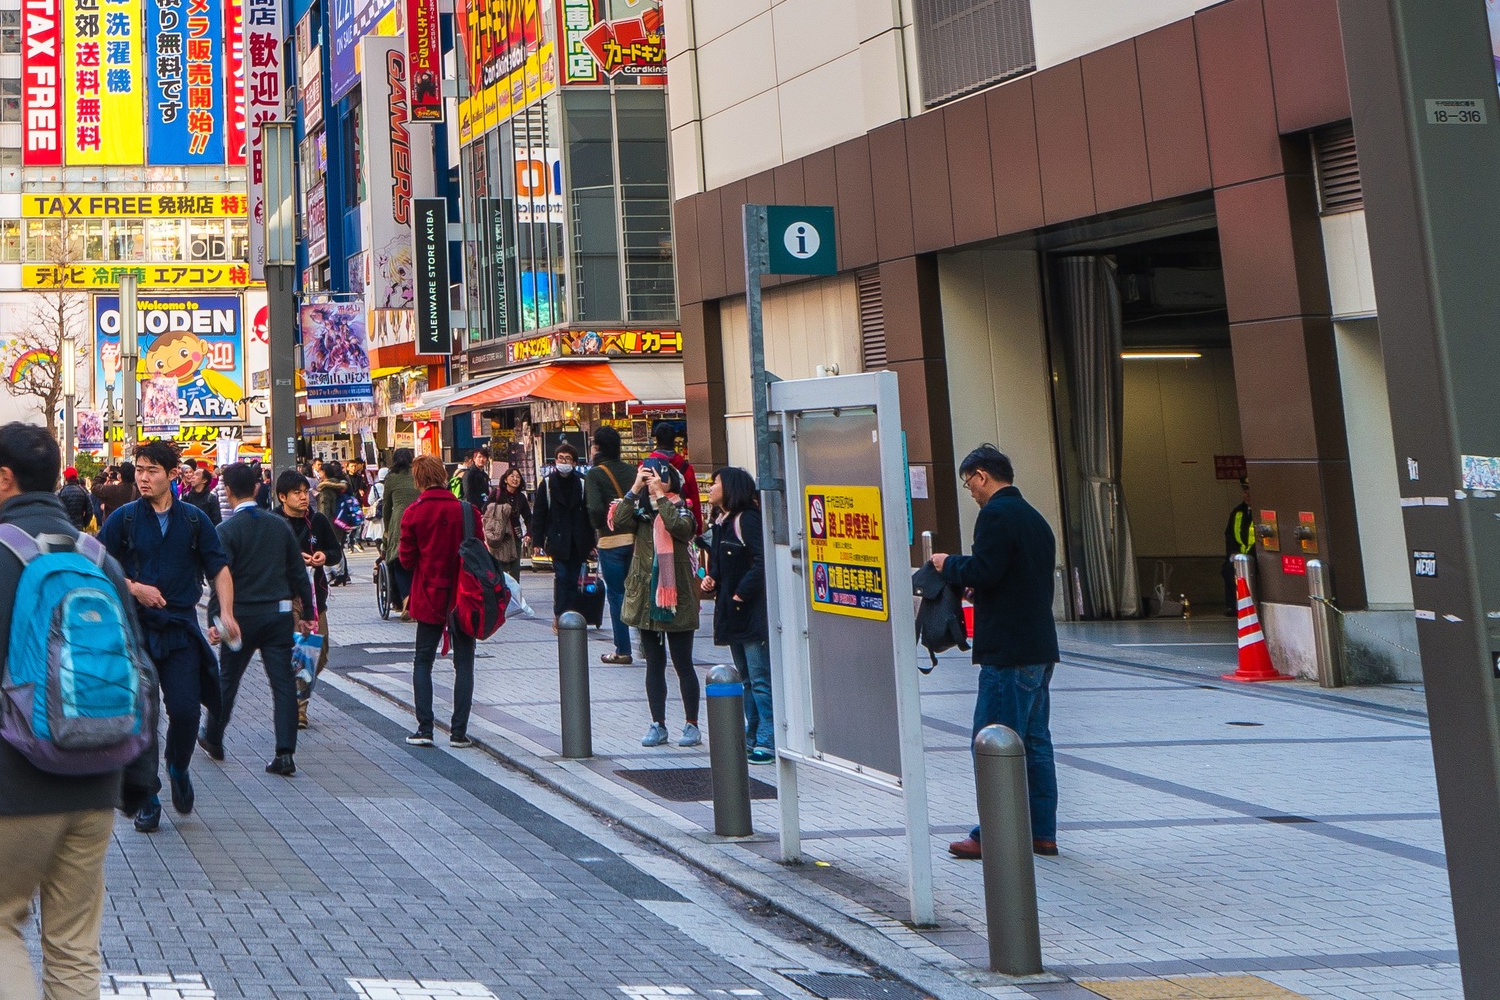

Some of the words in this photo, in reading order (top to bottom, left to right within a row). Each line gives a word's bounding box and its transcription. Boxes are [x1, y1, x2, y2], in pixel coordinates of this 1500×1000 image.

[27, 66, 57, 151] FREE
[1434, 110, 1481, 123] 18-316
[385, 48, 413, 226] GAMERS
[34, 197, 82, 215] TAX
[89, 196, 153, 214] FREE
[158, 195, 214, 214] 免税店
[426, 209, 434, 242] AKIBA
[35, 267, 87, 285] テレビ
[92, 266, 147, 284] 冷蔵庫
[153, 267, 222, 284] エアコン
[428, 244, 436, 278] STORE
[137, 300, 184, 311] Welcome
[186, 300, 199, 311] to
[428, 279, 439, 343] ALIENWARE
[828, 511, 880, 541] 路上喫煙禁止
[828, 565, 882, 593] 放置自転車禁止
